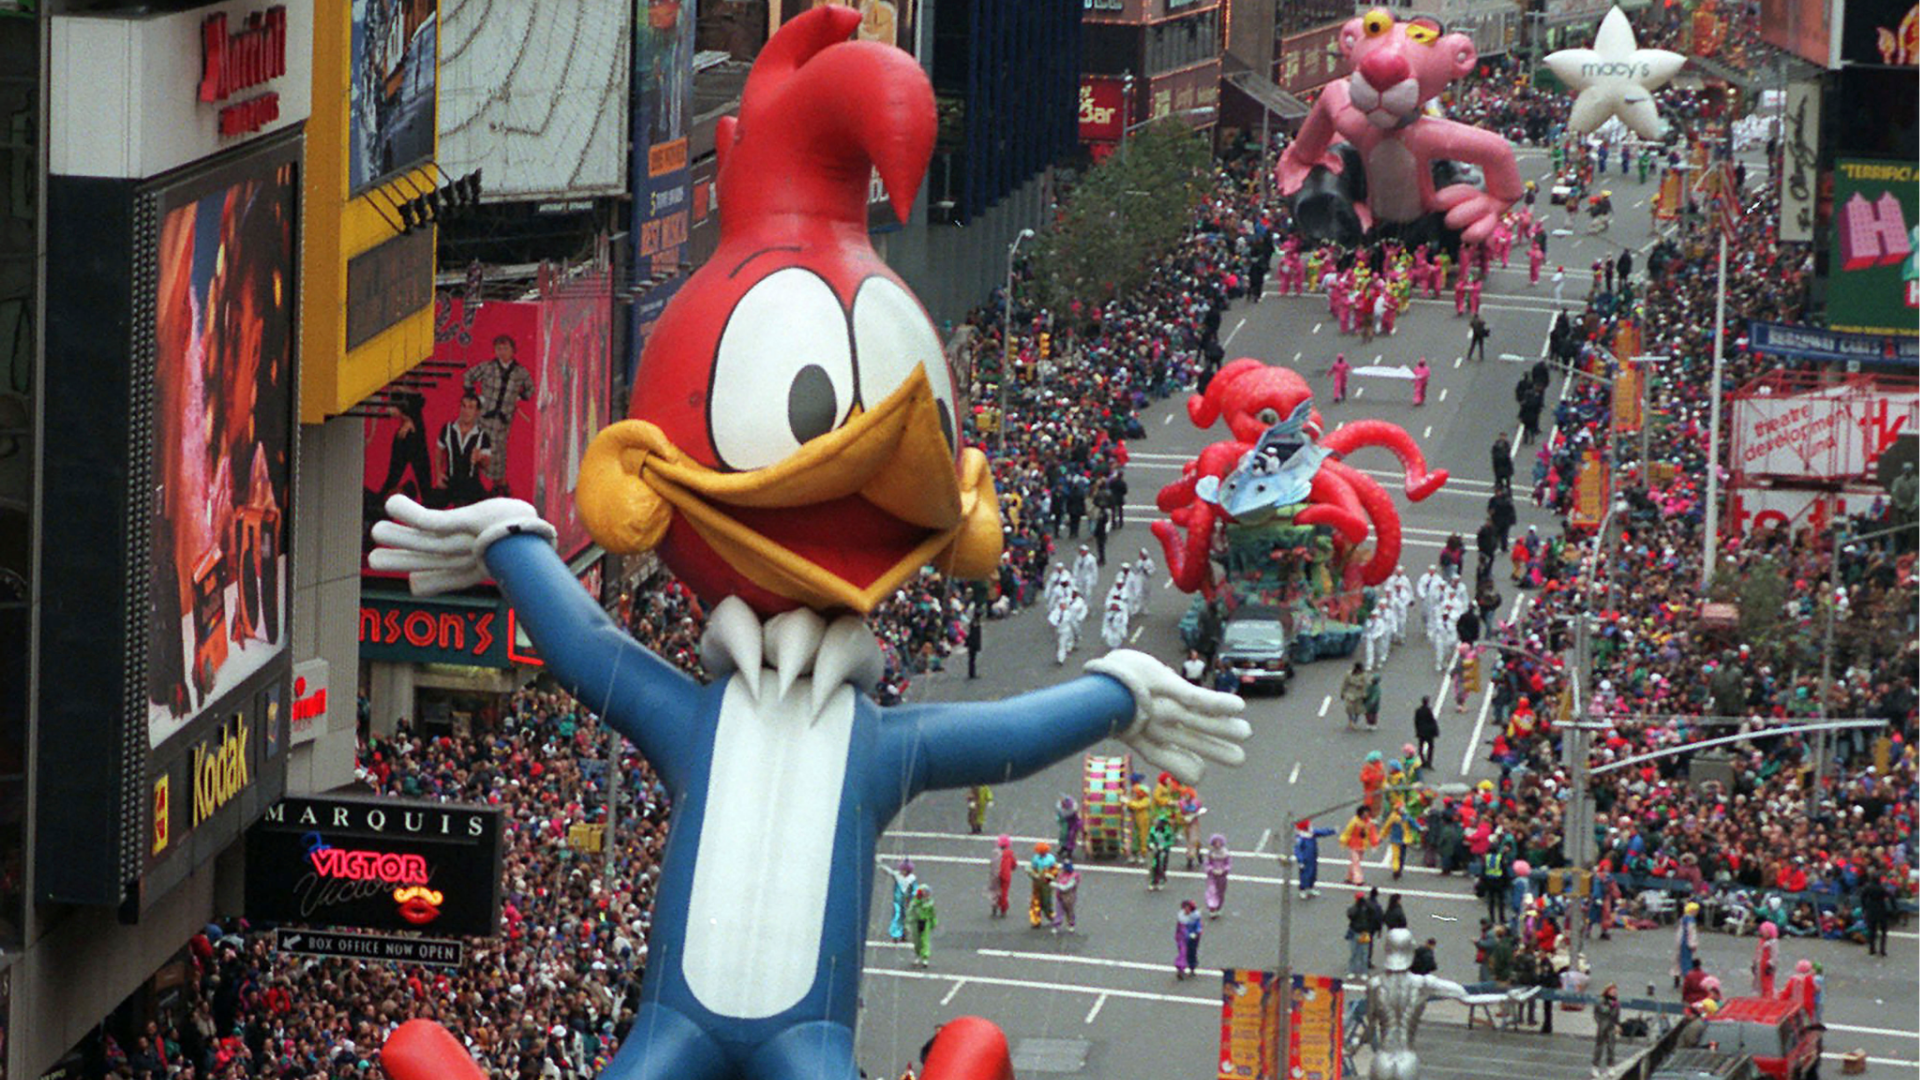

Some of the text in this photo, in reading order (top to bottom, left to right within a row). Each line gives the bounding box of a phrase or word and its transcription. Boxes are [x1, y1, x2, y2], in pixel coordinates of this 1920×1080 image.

[1581, 61, 1650, 78] macy's
[1743, 404, 1853, 462] development
[1754, 403, 1811, 438] theatre
[359, 607, 495, 655] nson's
[193, 711, 249, 828] Kodak
[264, 803, 483, 836] MARQUIS
[311, 848, 428, 884] VICTOR
[309, 936, 454, 961] BOX OFFICE NOW OPEN
